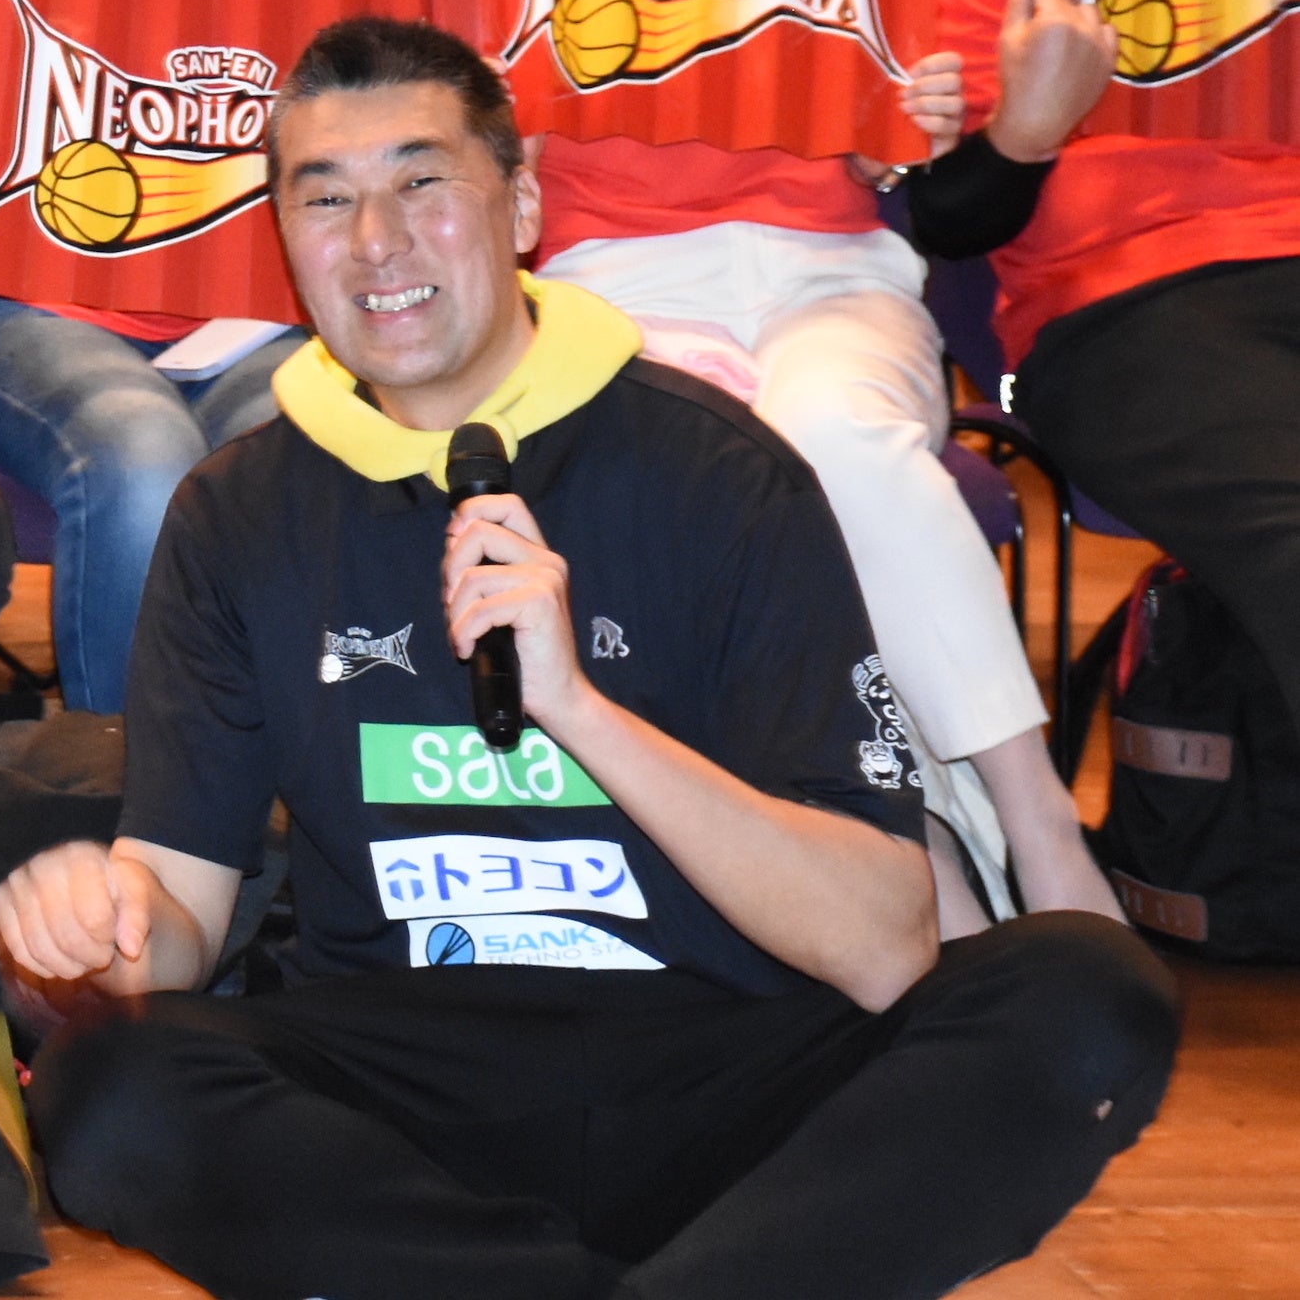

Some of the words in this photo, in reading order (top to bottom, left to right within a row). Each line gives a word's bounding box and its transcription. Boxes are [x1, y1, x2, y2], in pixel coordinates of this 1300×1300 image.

[172, 51, 270, 86] SAN-EN
[8, 8, 275, 190] NEOPHO
[433, 852, 627, 899] トヨコン
[482, 925, 618, 955] SANK
